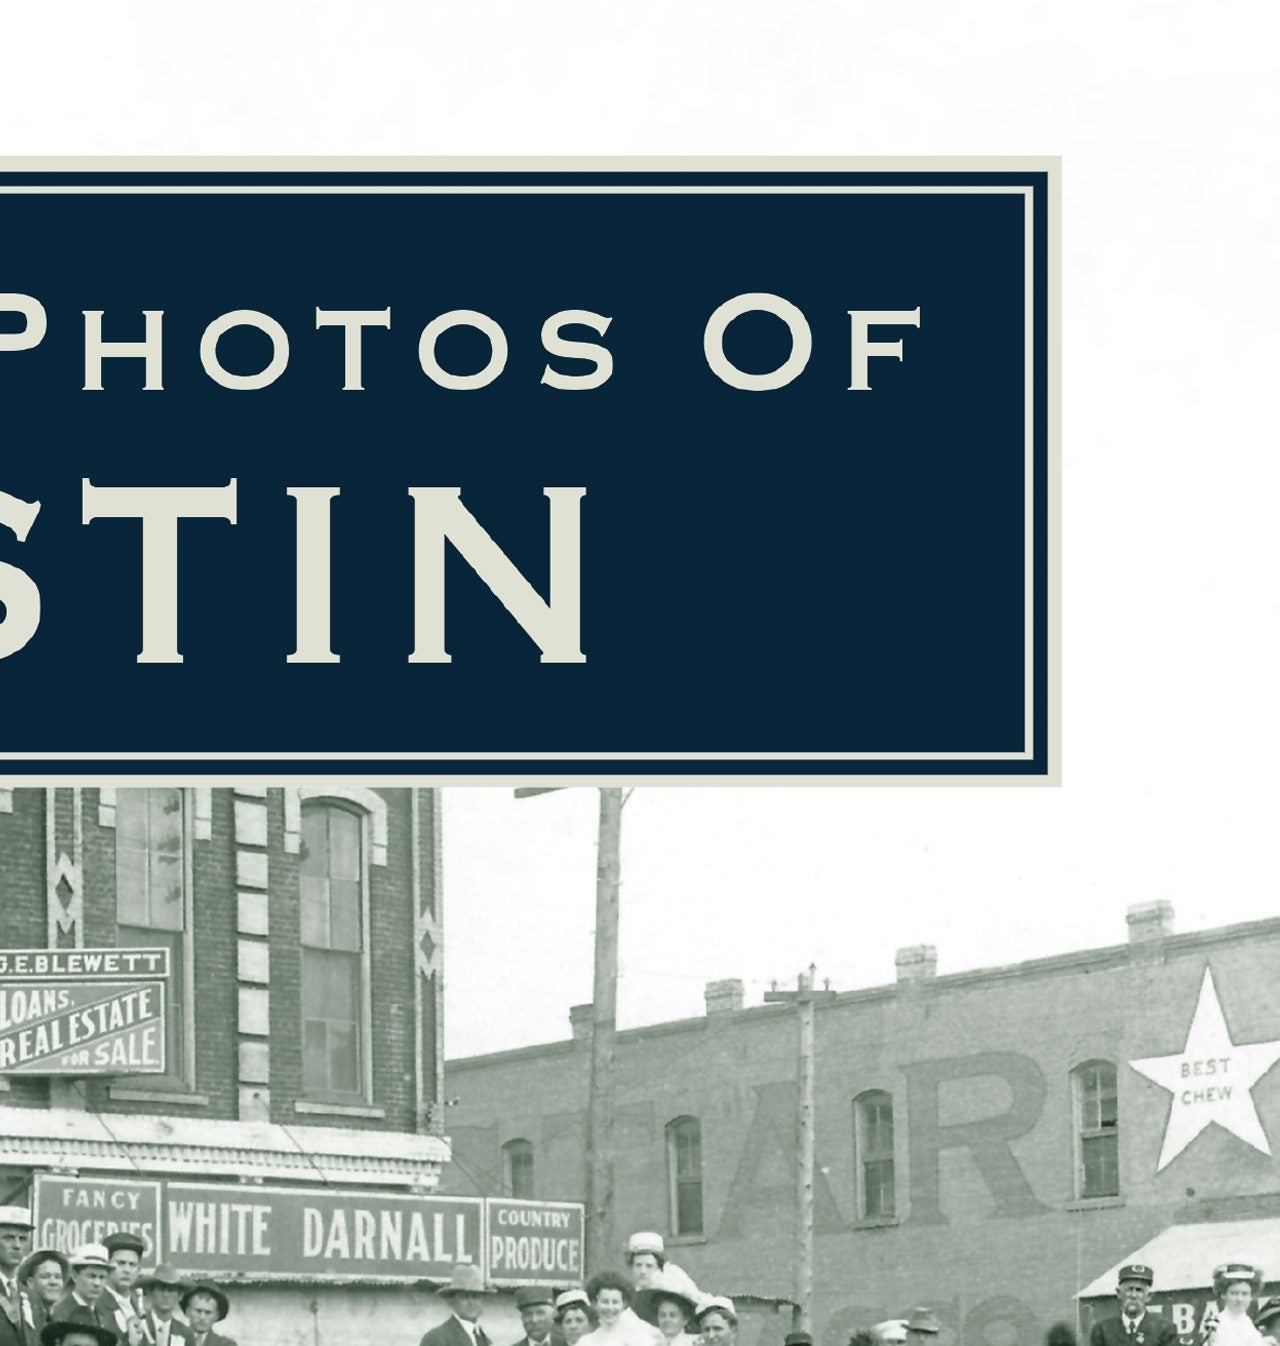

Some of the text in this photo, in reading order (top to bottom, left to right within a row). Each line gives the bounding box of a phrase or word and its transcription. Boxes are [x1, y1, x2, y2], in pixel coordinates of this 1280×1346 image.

[0, 988, 153, 1069] REAL ESTATE
[61, 1050, 90, 1066] FOR
[1180, 1057, 1231, 1078] BEST
[1181, 1086, 1233, 1105] CHEW
[62, 1188, 141, 1211] FANCY
[498, 1208, 571, 1229] COUNTRY
[169, 1201, 473, 1264] WHITE DARNALL
[491, 1235, 580, 1273] PRODUCE
